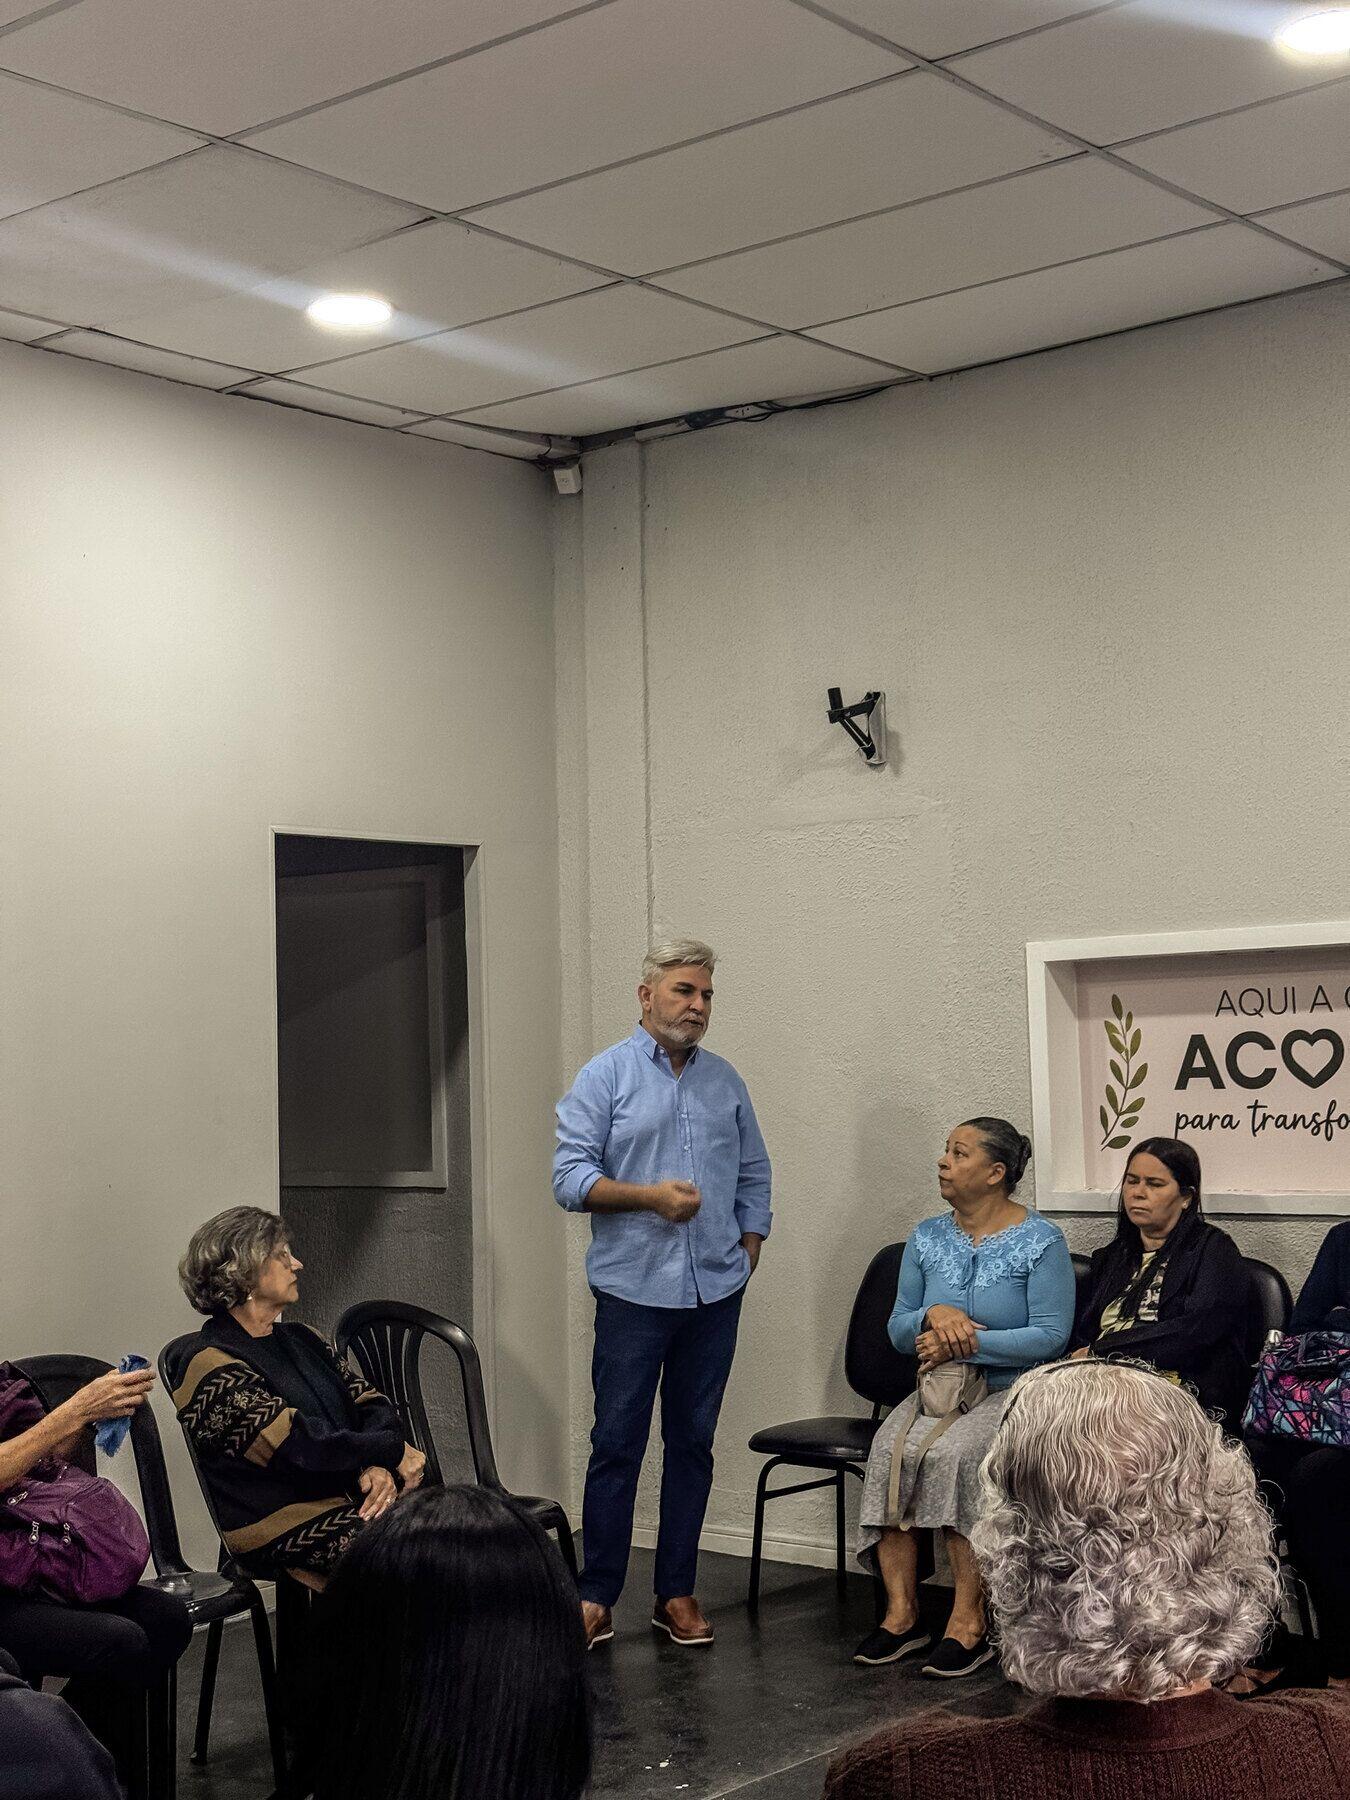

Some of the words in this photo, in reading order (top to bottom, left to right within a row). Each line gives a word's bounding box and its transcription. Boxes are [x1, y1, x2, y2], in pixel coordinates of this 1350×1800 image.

[1215, 986, 1297, 1018] AQUI
[1309, 985, 1334, 1013] A
[1174, 1111, 1240, 1140] para
